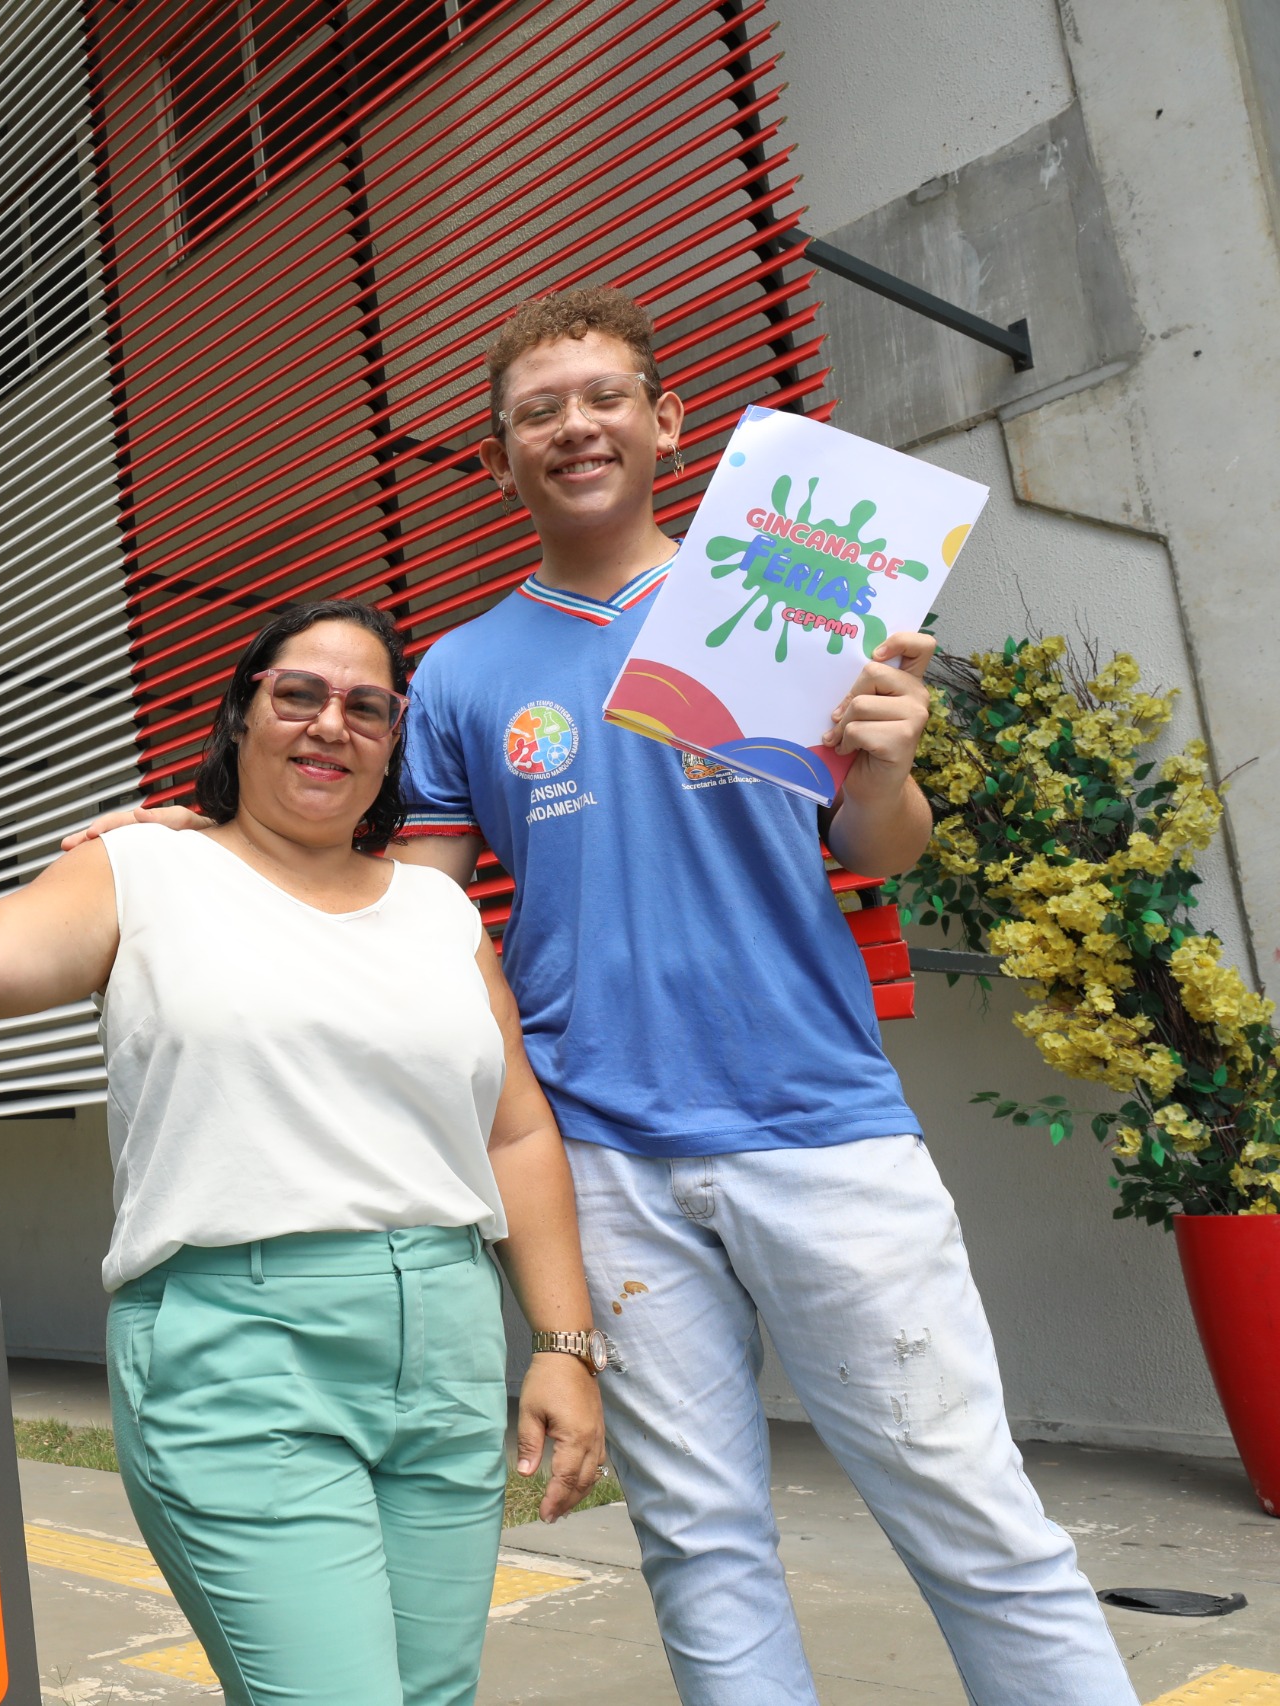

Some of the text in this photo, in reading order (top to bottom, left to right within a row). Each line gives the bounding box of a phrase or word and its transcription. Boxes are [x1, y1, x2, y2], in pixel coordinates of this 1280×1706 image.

[746, 507, 905, 580] GINCANA DE
[738, 534, 878, 615] FÉRIAS
[781, 607, 859, 639] CEPPMM
[530, 780, 578, 804] ENSINO
[681, 779, 718, 790] Secretaria
[718, 777, 727, 785] da
[525, 791, 598, 827] FNDAMENTAL
